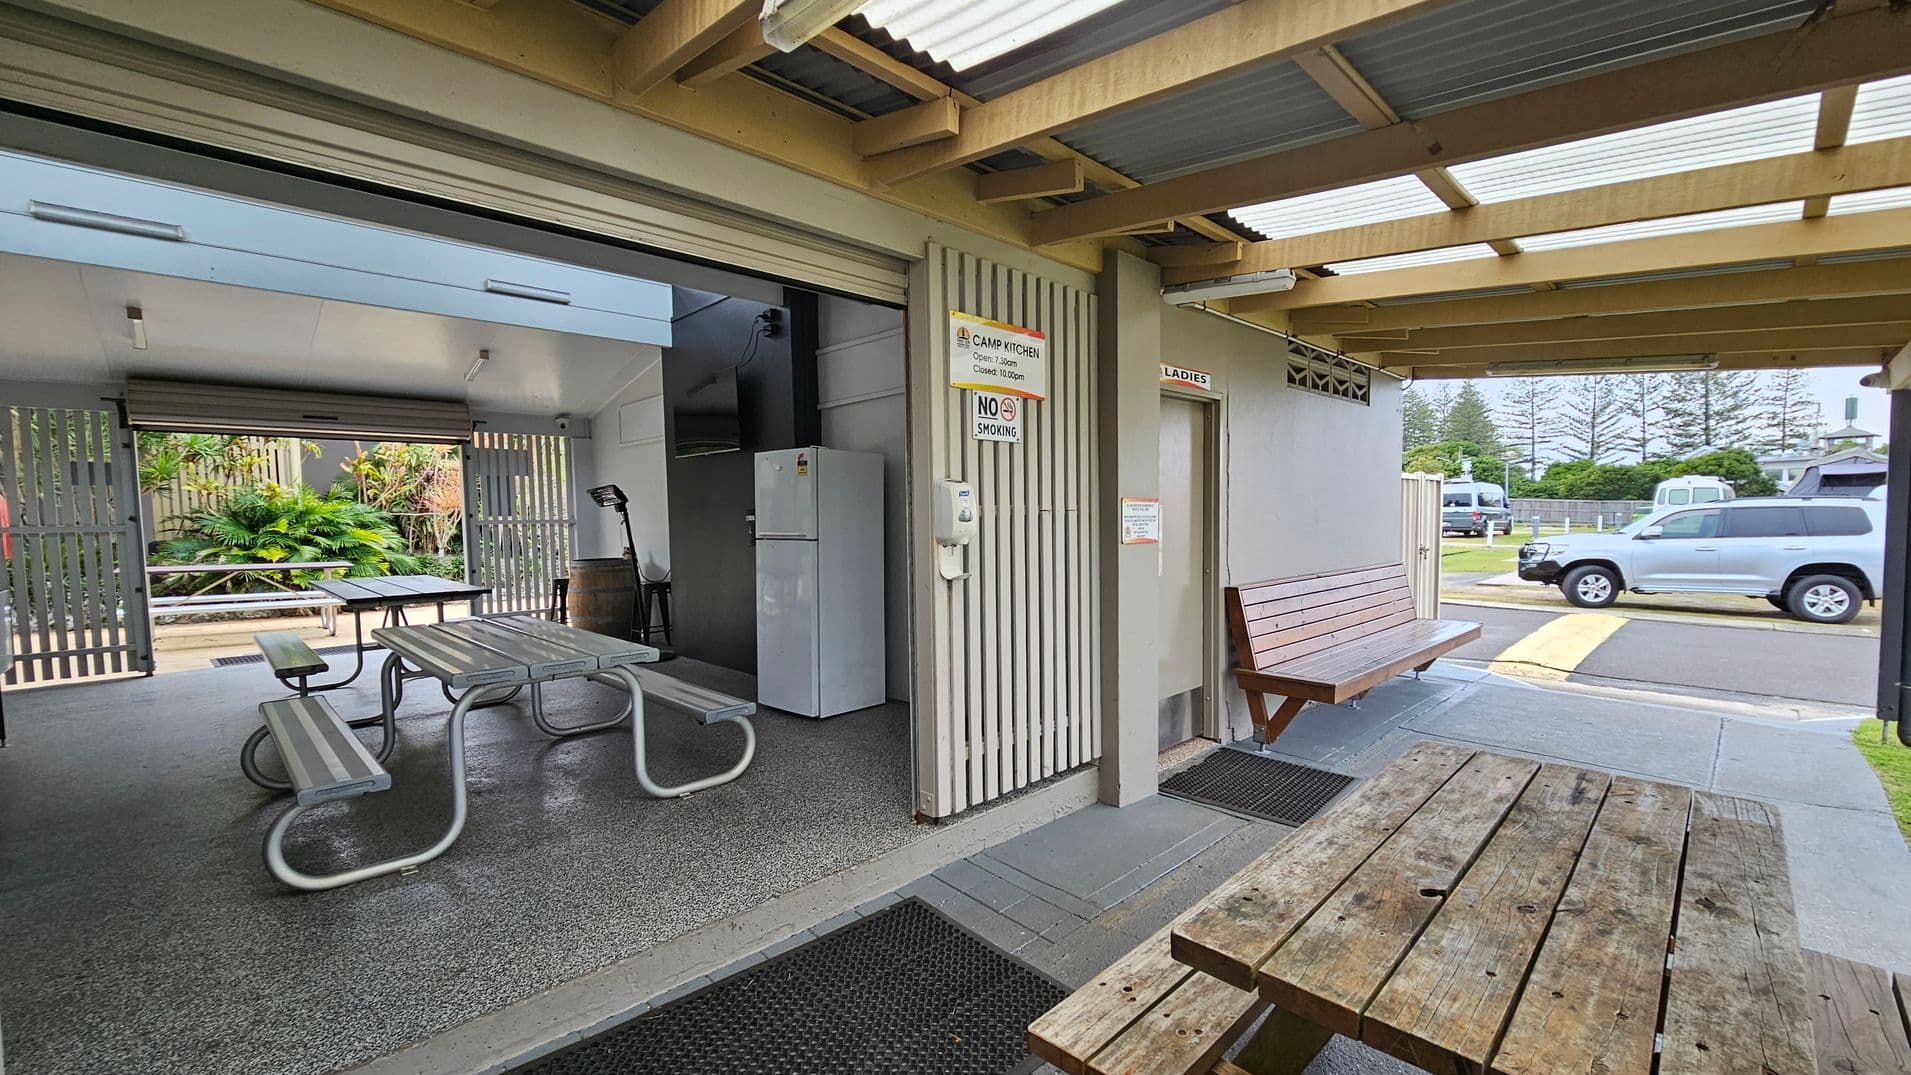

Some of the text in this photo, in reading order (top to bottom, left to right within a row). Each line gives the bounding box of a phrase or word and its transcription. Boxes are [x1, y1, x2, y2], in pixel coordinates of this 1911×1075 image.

[973, 334, 1002, 350] CAMP
[1004, 341, 1040, 359] KITCHEN
[973, 352, 994, 363] Open:
[973, 364, 1025, 381] Closed: 10.00pm
[1165, 367, 1207, 384] LADIES
[978, 396, 998, 416] NO
[978, 423, 1017, 438] SMOKING
